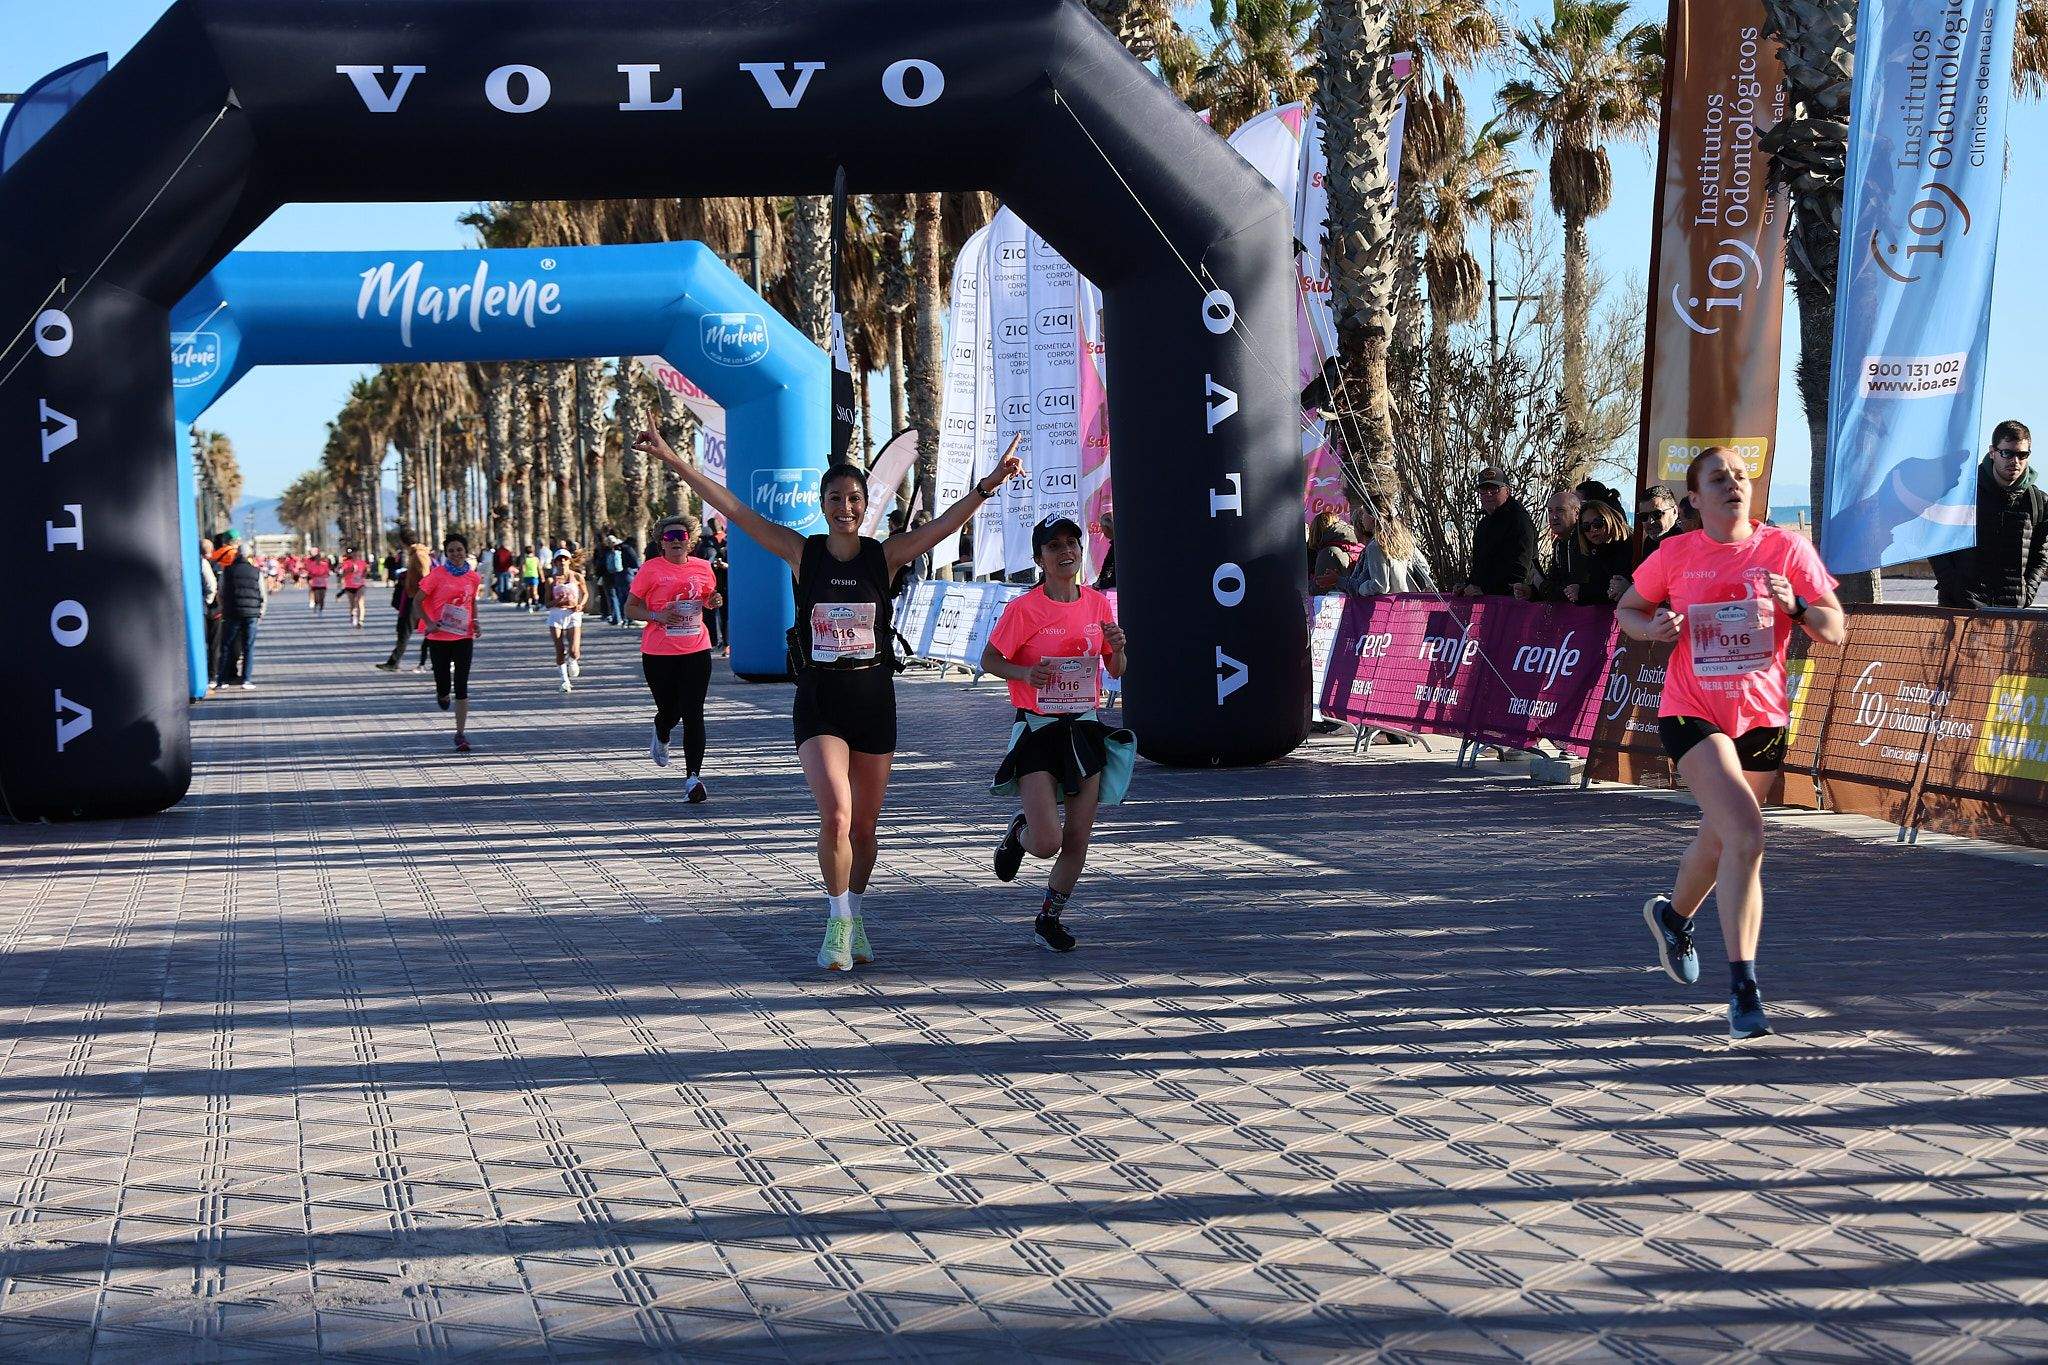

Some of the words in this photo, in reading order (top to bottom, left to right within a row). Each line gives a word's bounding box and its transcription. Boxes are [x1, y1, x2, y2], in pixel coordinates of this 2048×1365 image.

[1976, 8, 1994, 90] dentales
[336, 59, 945, 113] VOLVO
[1898, 30, 1931, 170] Institutos
[1725, 28, 1762, 227] Odontológicos
[1970, 95, 1988, 167] Clínicas
[1694, 94, 1724, 227] Institutos
[706, 326, 764, 352] Marlene
[172, 345, 216, 368] arlene
[1868, 364, 1902, 376] 900
[1906, 364, 1930, 376] 131
[1933, 360, 1959, 376] 002
[1868, 376, 1957, 392] www.ioa.es
[756, 482, 818, 514] Marlene
[1202, 289, 1248, 706] VOLVO
[35, 309, 93, 752] VOLVO
[1682, 570, 1716, 579] OYSHO
[832, 628, 855, 639] 016
[1720, 634, 1750, 646] 016
[1418, 622, 1478, 678] renfe
[1512, 630, 1580, 690] renfe
[1060, 681, 1080, 690] 016
[1414, 684, 1433, 702] TREN
[1432, 688, 1458, 706] OFICIAL
[1508, 698, 1530, 715] TREN
[1888, 708, 1974, 740] Odontológicos
[1881, 746, 1903, 760] Clínica
